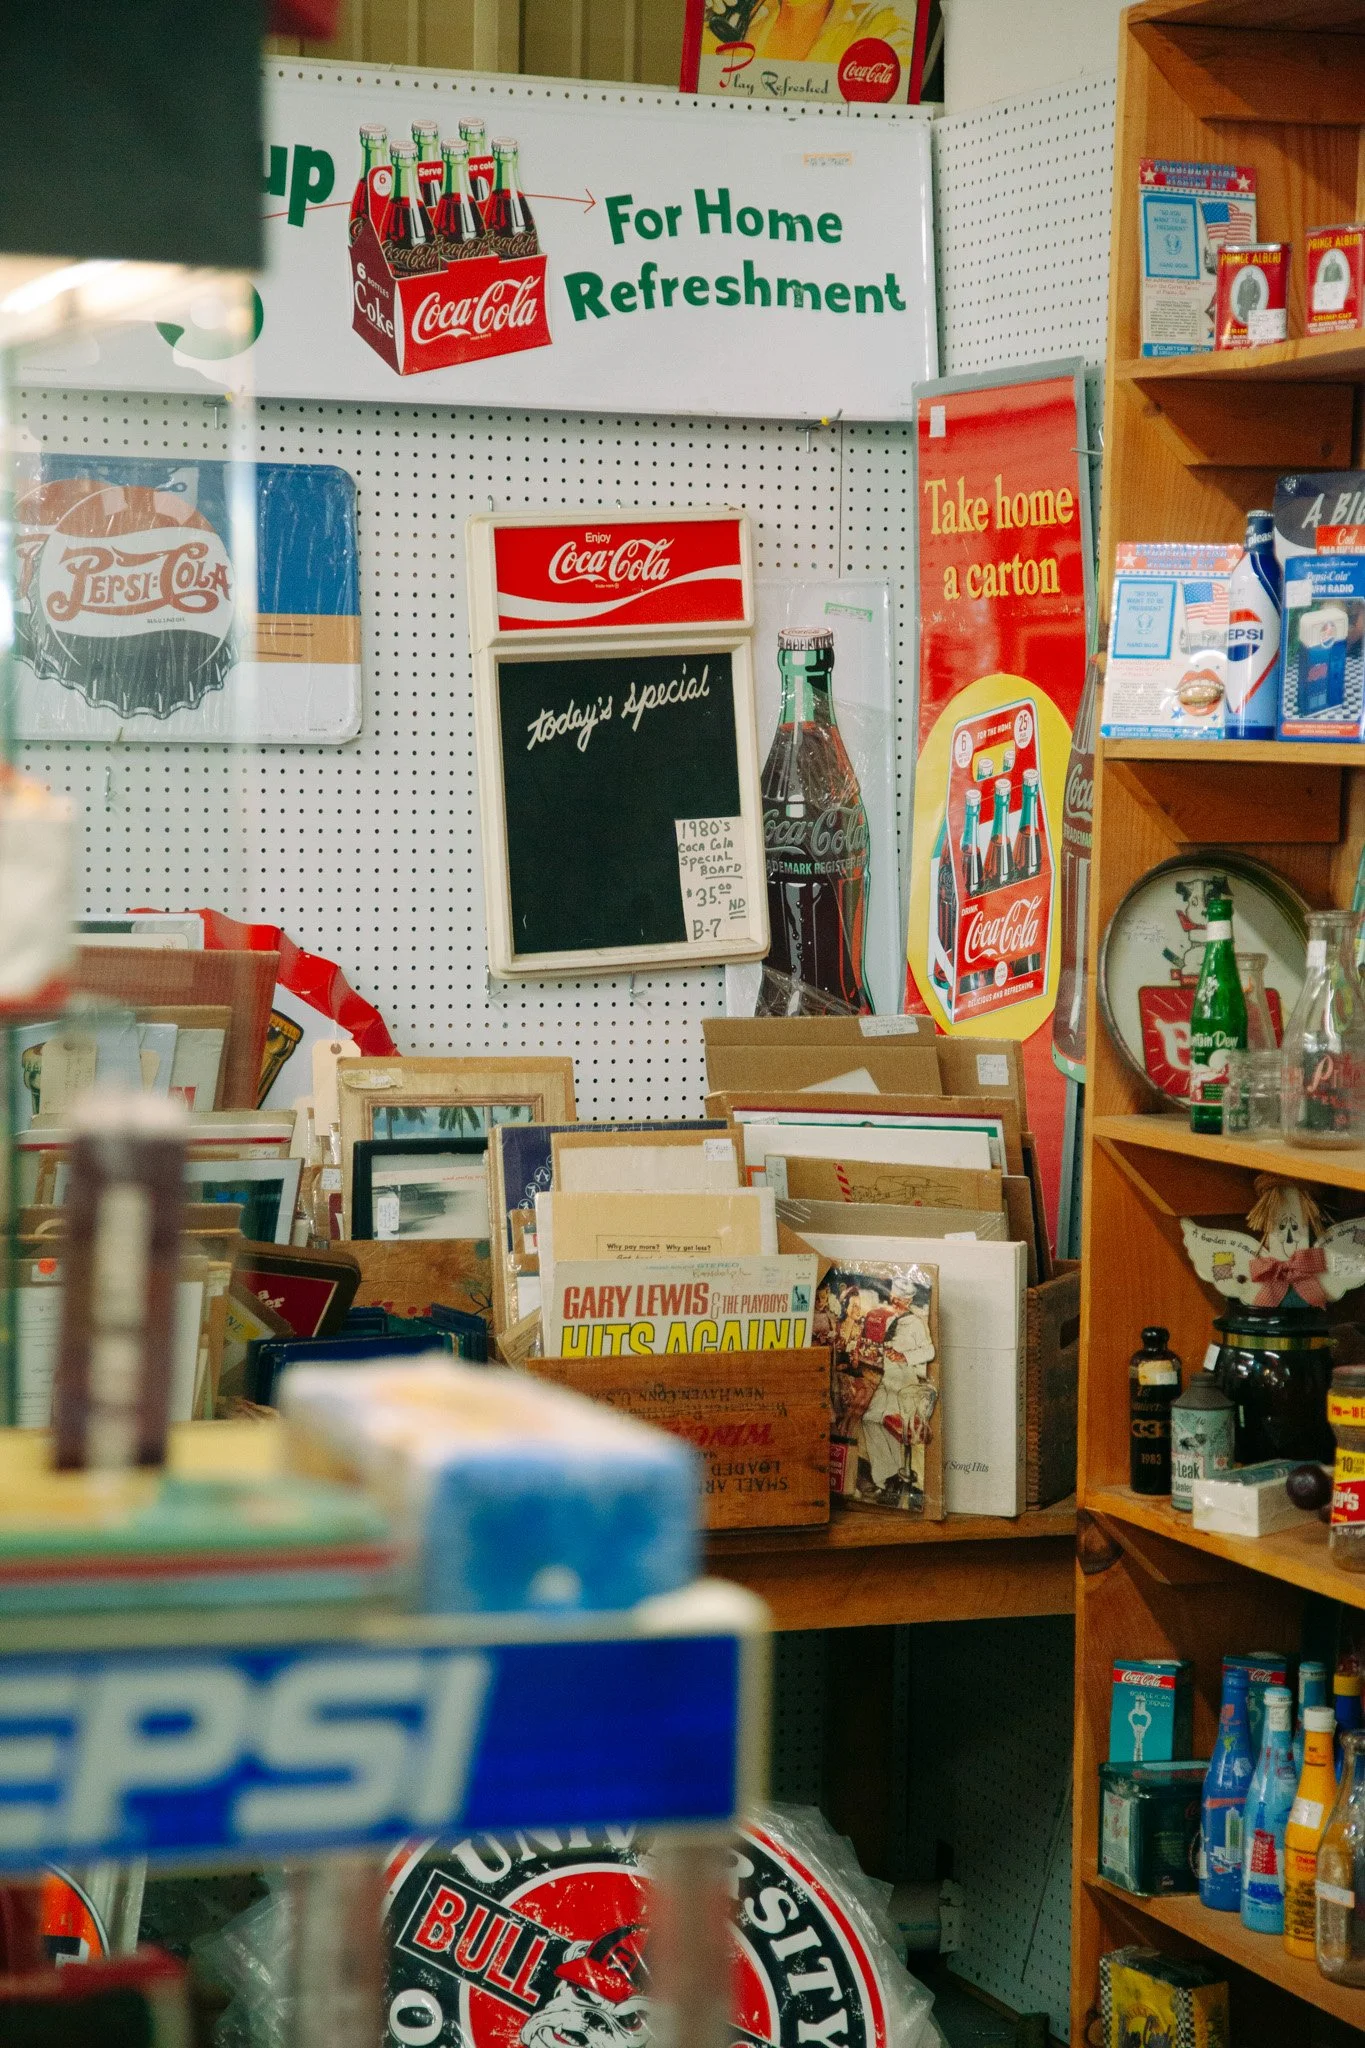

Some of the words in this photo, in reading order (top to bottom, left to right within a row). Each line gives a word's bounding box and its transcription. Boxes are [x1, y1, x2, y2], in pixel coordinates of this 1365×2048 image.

[715, 42, 756, 95] Play
[761, 71, 830, 97] Refreshed
[842, 61, 896, 84] Coca-Cola
[418, 167, 443, 177] Serve
[604, 194, 683, 245] For
[694, 187, 844, 244] Home
[356, 262, 367, 279] 6
[563, 260, 907, 322] Refreshment
[354, 281, 395, 339] Coke
[411, 275, 541, 345] Coca-Cola
[924, 475, 990, 536] Take
[994, 473, 1075, 530] home
[1302, 493, 1325, 529] A
[585, 532, 612, 544] Enjoy
[548, 538, 676, 585] Coca-Cola
[943, 565, 961, 601] a
[966, 552, 1061, 600] carton
[1327, 584, 1355, 593] RADIO
[620, 661, 711, 732] special
[961, 734, 967, 752] 6
[987, 726, 998, 737] THE
[961, 904, 979, 917] DRINK
[964, 895, 1043, 963] Coca-Cola
[1213, 1030, 1239, 1048] Dew
[607, 1243, 623, 1251] Why
[666, 1244, 682, 1252] Why
[563, 1285, 633, 1320] GARY
[635, 1282, 710, 1317] LEWIS
[722, 1295, 739, 1315] THE
[741, 1293, 789, 1315] PLAYBOYS
[949, 1461, 972, 1474] Song
[971, 1462, 990, 1473] Hits
[1121, 1670, 1162, 1688] Coca-Cola
[412, 1884, 550, 2007] BULL
